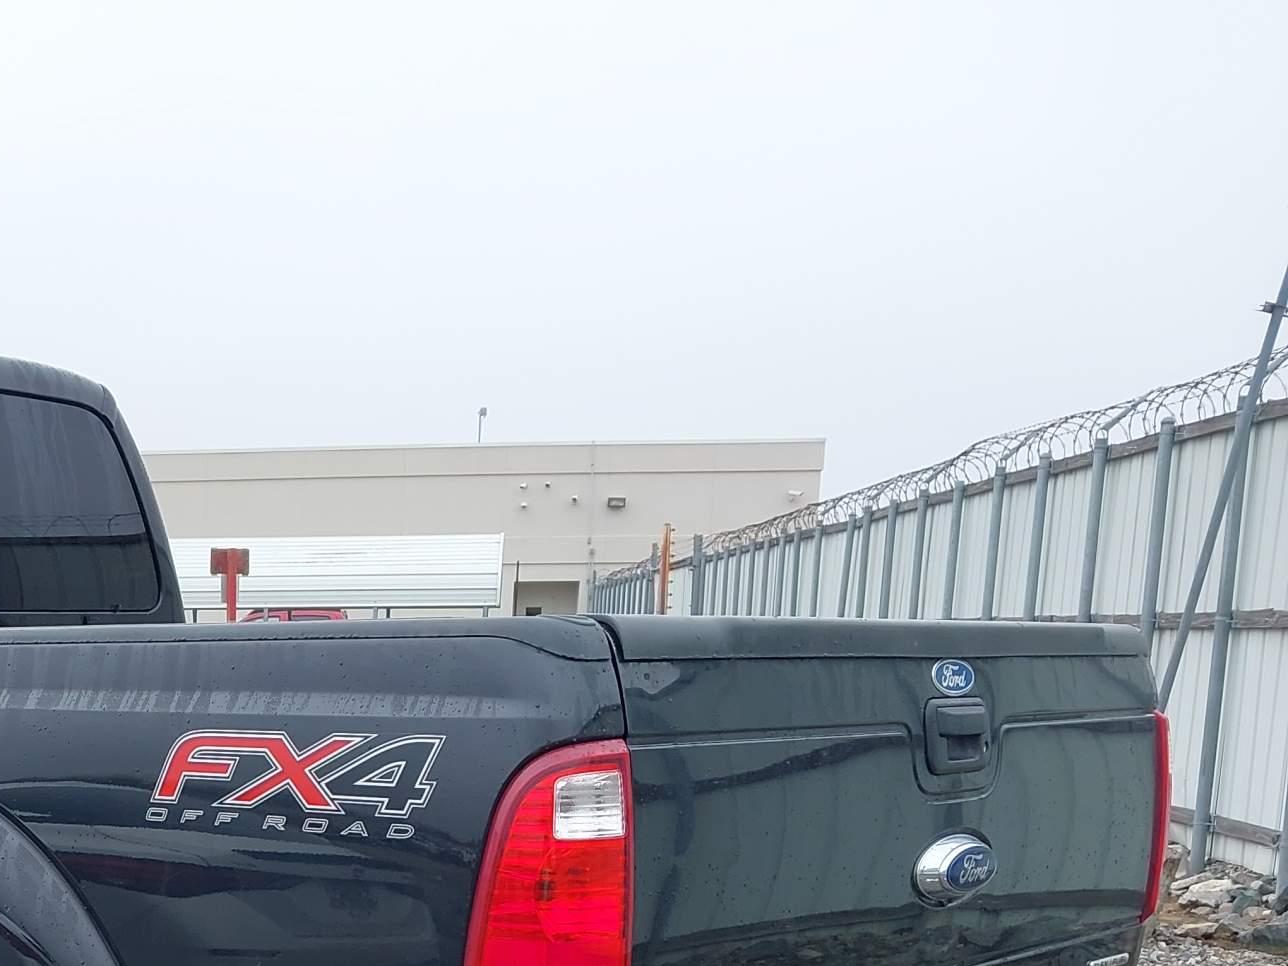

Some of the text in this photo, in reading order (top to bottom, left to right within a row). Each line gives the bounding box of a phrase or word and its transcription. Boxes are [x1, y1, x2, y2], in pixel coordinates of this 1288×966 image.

[150, 729, 447, 819] FX4
[145, 807, 415, 840] OFF ROAD
